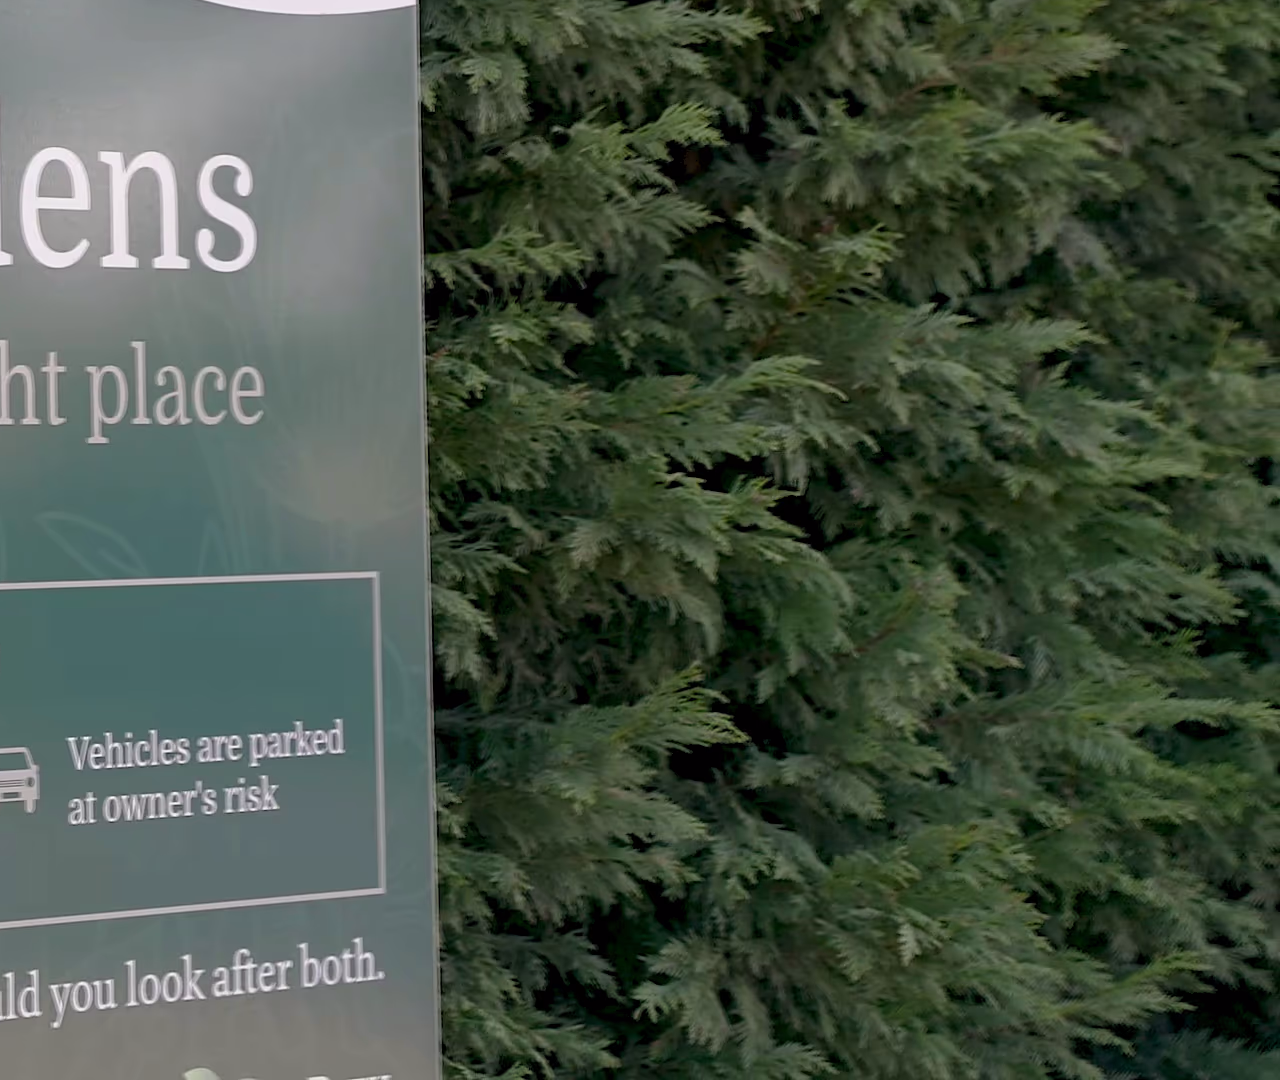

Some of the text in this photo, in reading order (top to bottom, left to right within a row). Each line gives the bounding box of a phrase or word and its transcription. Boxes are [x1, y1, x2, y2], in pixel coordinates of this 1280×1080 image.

[85, 341, 264, 443] place
[66, 719, 346, 770] Vehicles are parked
[68, 792, 97, 824] at
[223, 775, 280, 813] risk
[49, 979, 118, 1028] you
[124, 954, 206, 1006] look
[212, 949, 293, 997] after
[297, 937, 385, 987] both.
